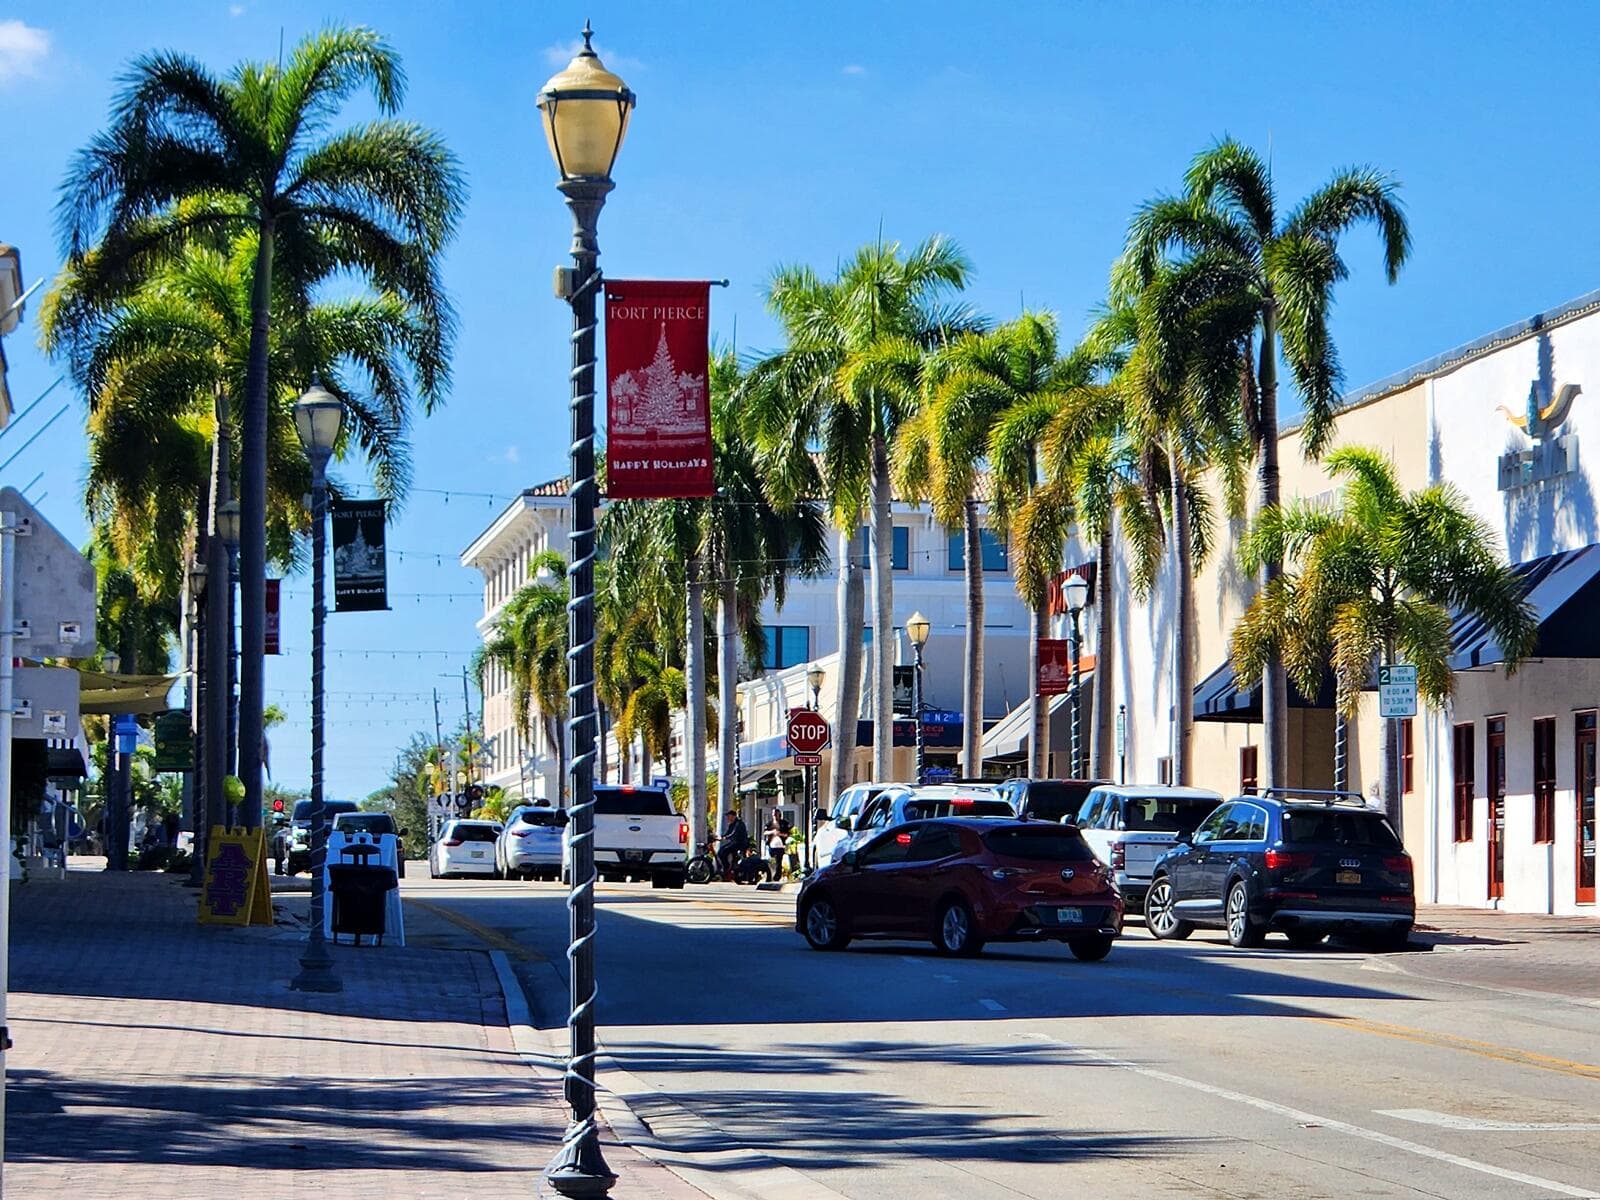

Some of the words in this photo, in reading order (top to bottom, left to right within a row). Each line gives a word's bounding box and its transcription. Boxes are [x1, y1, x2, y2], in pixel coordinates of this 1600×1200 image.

[611, 306, 648, 320] FORT
[653, 306, 705, 320] PIERCE
[613, 460, 650, 470] HAPPY
[653, 458, 708, 470] HOLIDAYS
[1380, 669, 1390, 683] 2
[934, 713, 941, 722] N
[790, 724, 826, 740] STOP
